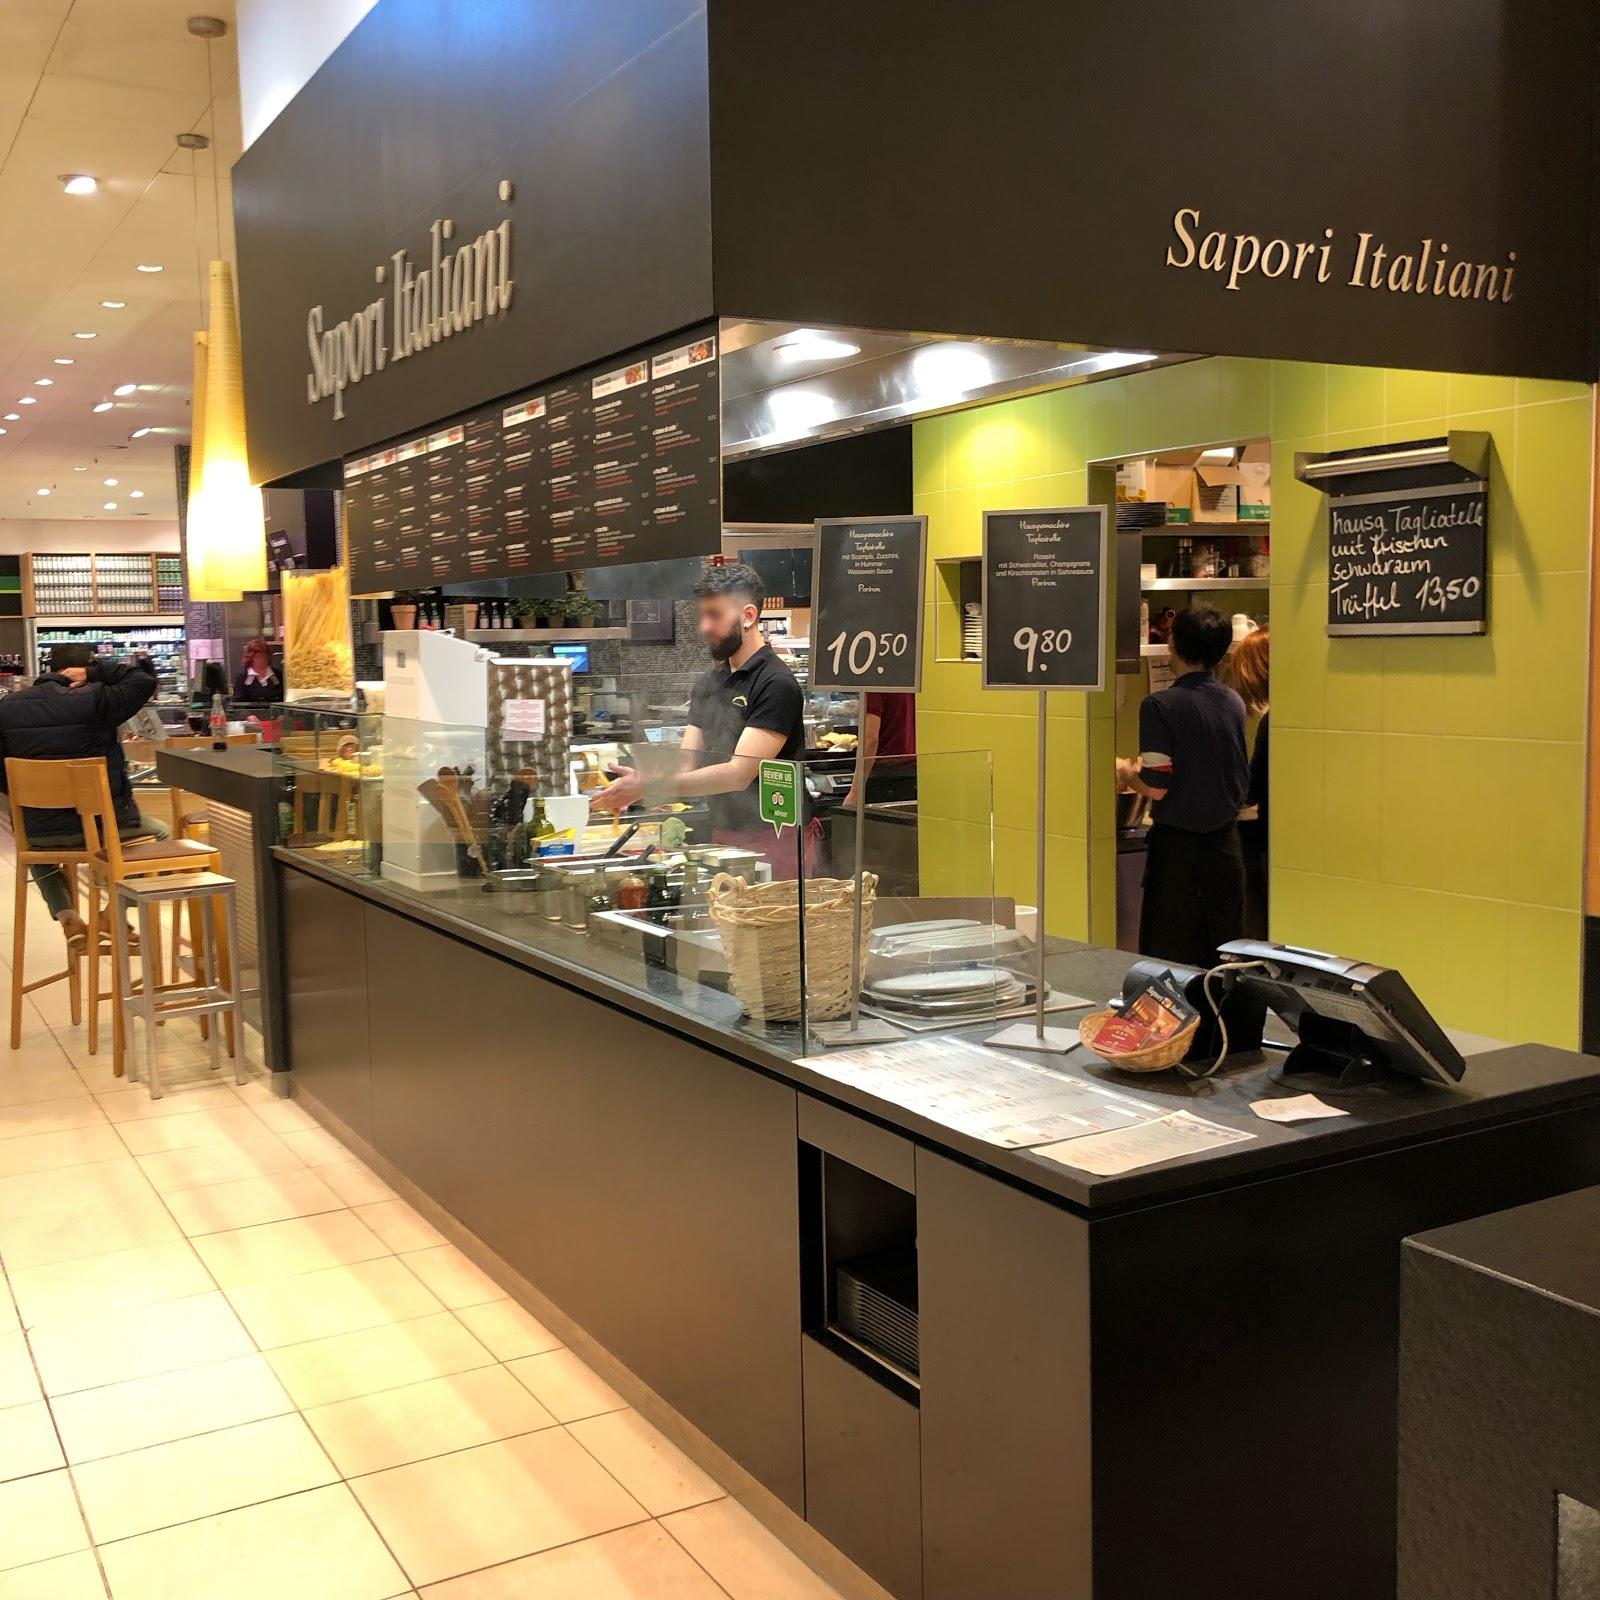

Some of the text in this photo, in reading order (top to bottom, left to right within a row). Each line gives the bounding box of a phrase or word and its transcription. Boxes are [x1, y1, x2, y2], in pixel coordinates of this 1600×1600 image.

[1165, 207, 1518, 304] Sapori Italiani
[306, 180, 514, 421] Sapori Italiani
[1333, 511, 1388, 540] hausg.
[1331, 534, 1366, 557] mit
[1415, 576, 1480, 613] 13,50
[1013, 626, 1073, 673] 9.80
[764, 770, 792, 782] REVIEW US
